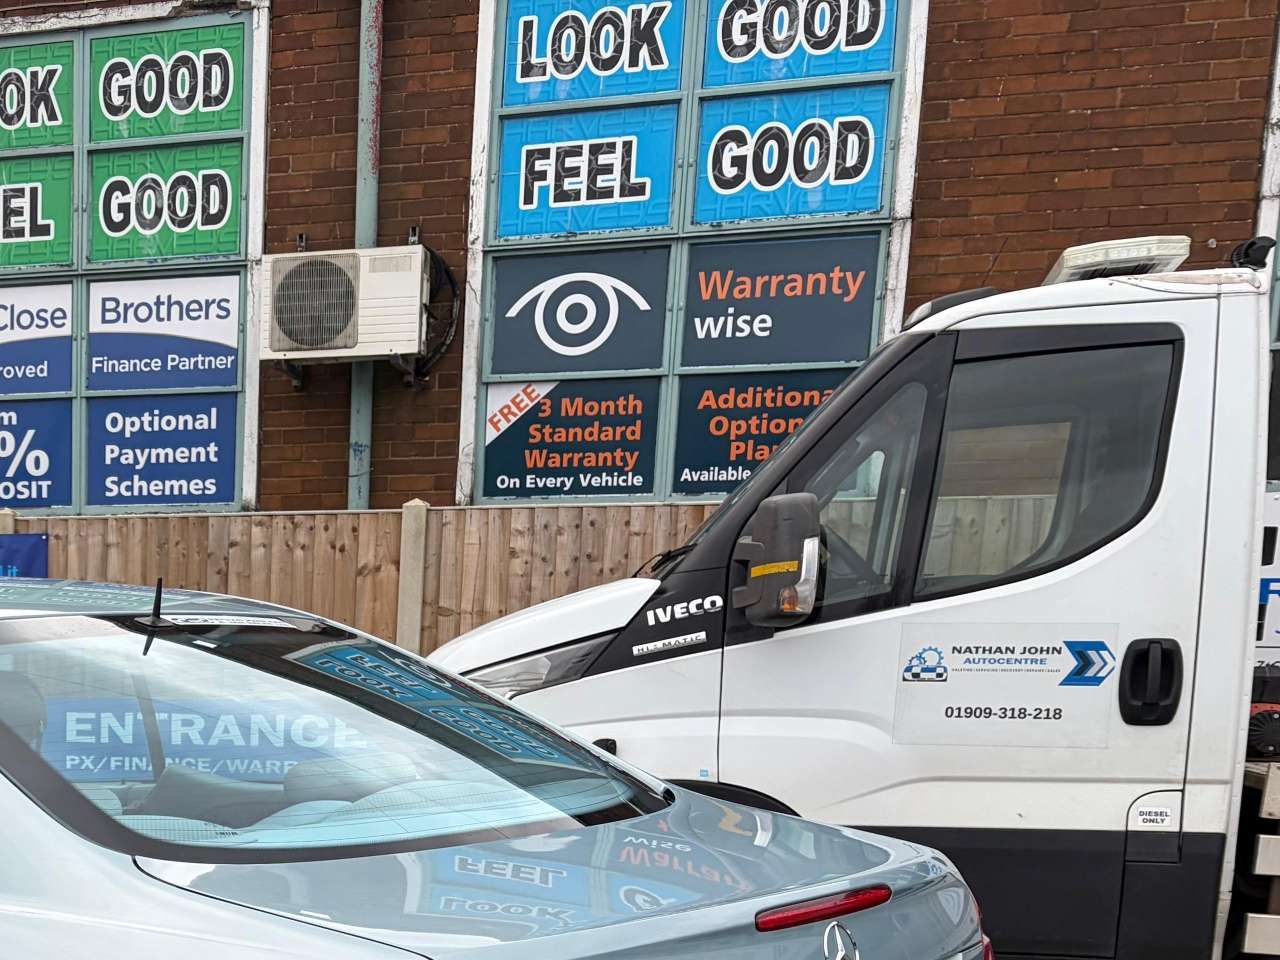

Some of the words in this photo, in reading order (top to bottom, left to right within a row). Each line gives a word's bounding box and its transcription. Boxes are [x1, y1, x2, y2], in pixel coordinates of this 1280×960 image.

[516, 1, 672, 83] LOOK
[717, 0, 886, 63] GOOD
[99, 48, 234, 121] GOOD
[519, 135, 654, 210] FEEL
[708, 115, 874, 194] GOOD
[98, 169, 232, 237] GOOD
[698, 265, 866, 302] Warranty
[100, 295, 232, 325] Brothers
[694, 307, 773, 339] wise
[92, 355, 162, 375] Finance
[167, 354, 235, 371] Partner
[487, 383, 541, 433] FREE
[538, 398, 552, 418] 3
[560, 394, 643, 417] Month
[105, 408, 218, 437] Optional
[528, 420, 642, 444] Standard
[105, 445, 219, 470] Payment
[524, 448, 640, 471] Warranty
[729, 439, 780, 461] Pla
[105, 475, 217, 498] Schemes
[496, 474, 520, 489] On
[525, 474, 574, 491] Every
[579, 472, 644, 487] Vehicle
[680, 466, 752, 482] Available
[646, 595, 724, 626] IVECO
[951, 646, 1015, 655] NATHAN
[1019, 646, 1062, 655] JOHN
[944, 706, 1063, 720] 01909-318-218
